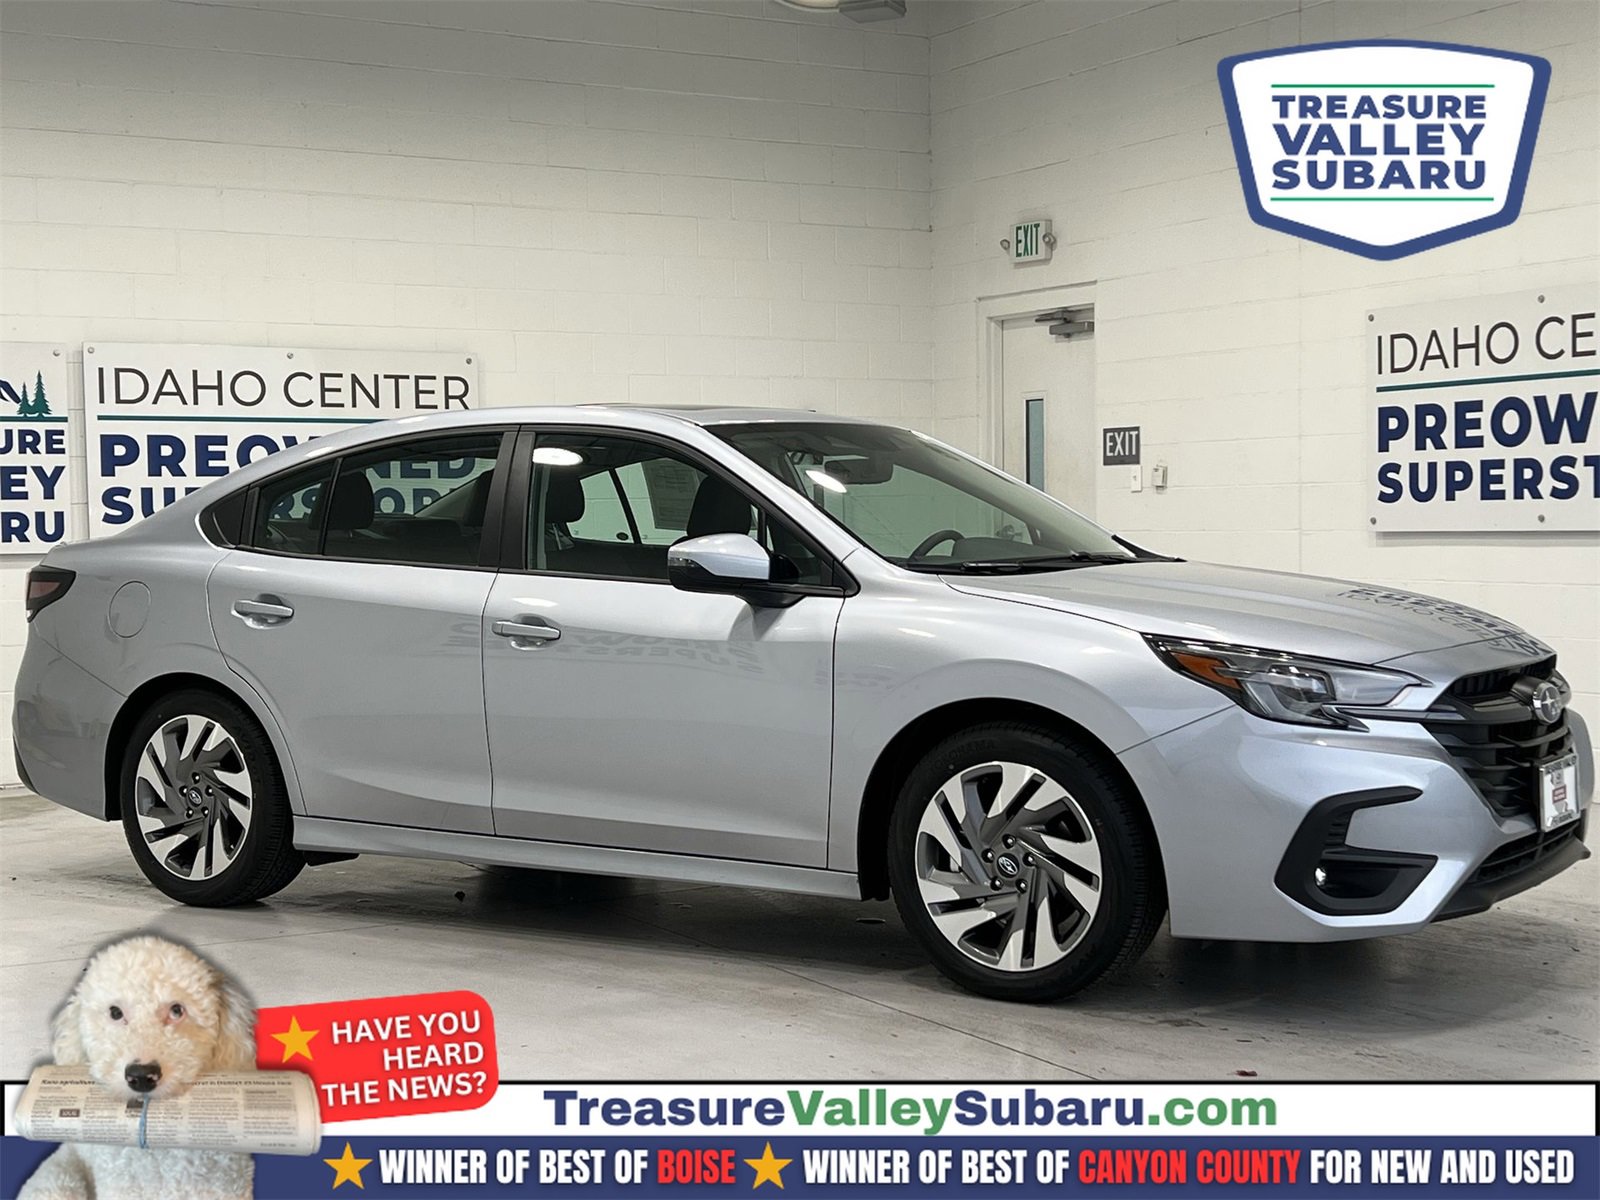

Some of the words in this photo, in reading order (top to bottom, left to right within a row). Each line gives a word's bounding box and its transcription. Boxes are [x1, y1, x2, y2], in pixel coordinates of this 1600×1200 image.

[1015, 223, 1041, 258] EXIT
[1377, 321, 1519, 375] IDAHO
[1535, 312, 1597, 360] CE
[98, 367, 266, 406] IDAHO
[283, 371, 471, 410] CENTER
[1378, 391, 1598, 453] PREOW
[1106, 430, 1139, 456] EXIT
[0, 466, 66, 500] EY
[1, 511, 65, 543] RU
